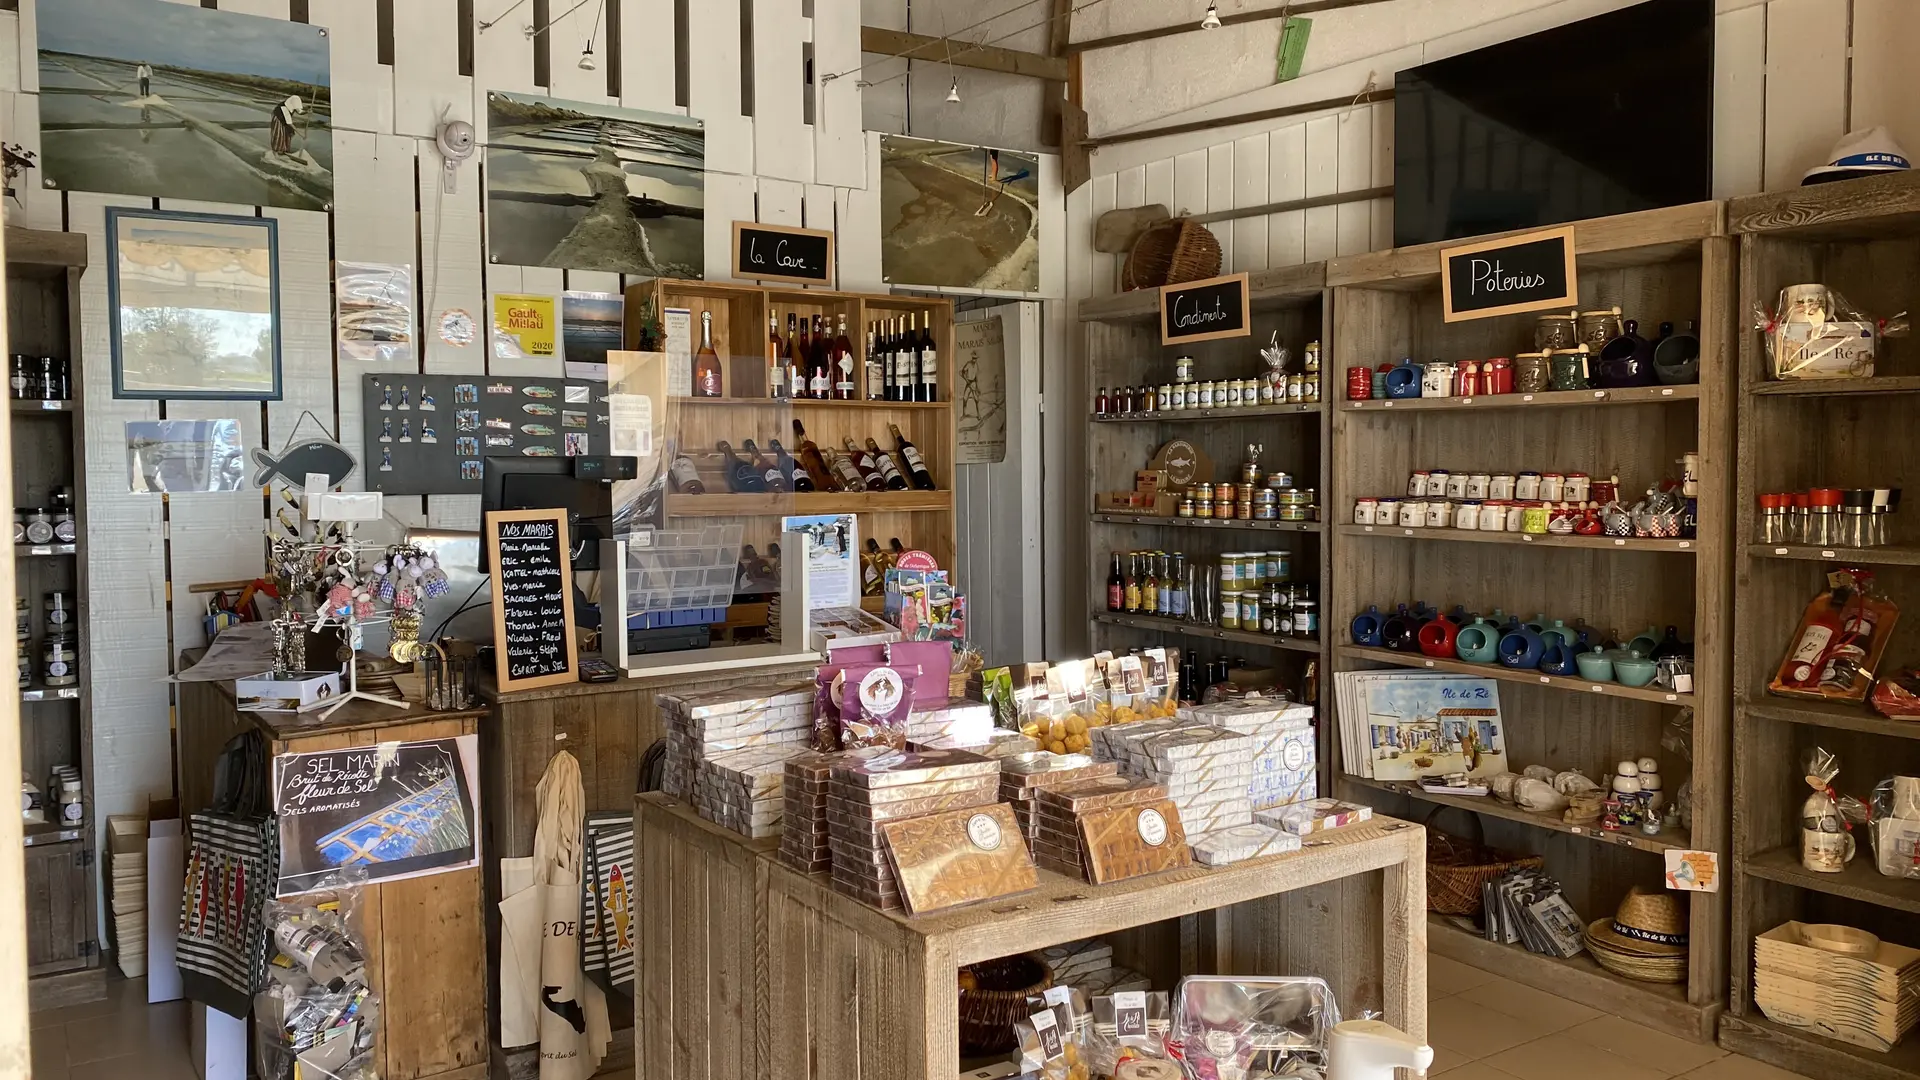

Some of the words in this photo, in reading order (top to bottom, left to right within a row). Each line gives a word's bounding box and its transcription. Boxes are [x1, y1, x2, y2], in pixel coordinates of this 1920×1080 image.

[776, 239, 807, 269] Cave
[1470, 259, 1545, 296] Poteries
[508, 307, 537, 318] Gault
[1174, 295, 1227, 328] Condiments
[508, 318, 543, 329] Millau
[531, 341, 553, 350] 2020
[1835, 348, 1854, 360] Ré
[1393, 386, 1405, 395] Sel
[521, 522, 554, 536] MARAIS
[506, 621, 536, 630] Thomas
[1360, 635, 1370, 643] Sel
[1507, 656, 1520, 664] Sel
[511, 663, 537, 676] ESPRIT
[1442, 687, 1457, 699] Ile
[1459, 687, 1471, 698] de
[1475, 687, 1490, 699] Ré
[306, 757, 340, 775] SEL
[346, 752, 400, 770] MARIN
[286, 773, 320, 790] Brut
[321, 773, 333, 782] de
[332, 768, 370, 785] Récolte
[337, 781, 352, 796] de
[353, 780, 378, 793] Sel
[551, 920, 577, 937] DE
[555, 1051, 567, 1060] du
[568, 1050, 577, 1059] Sel
